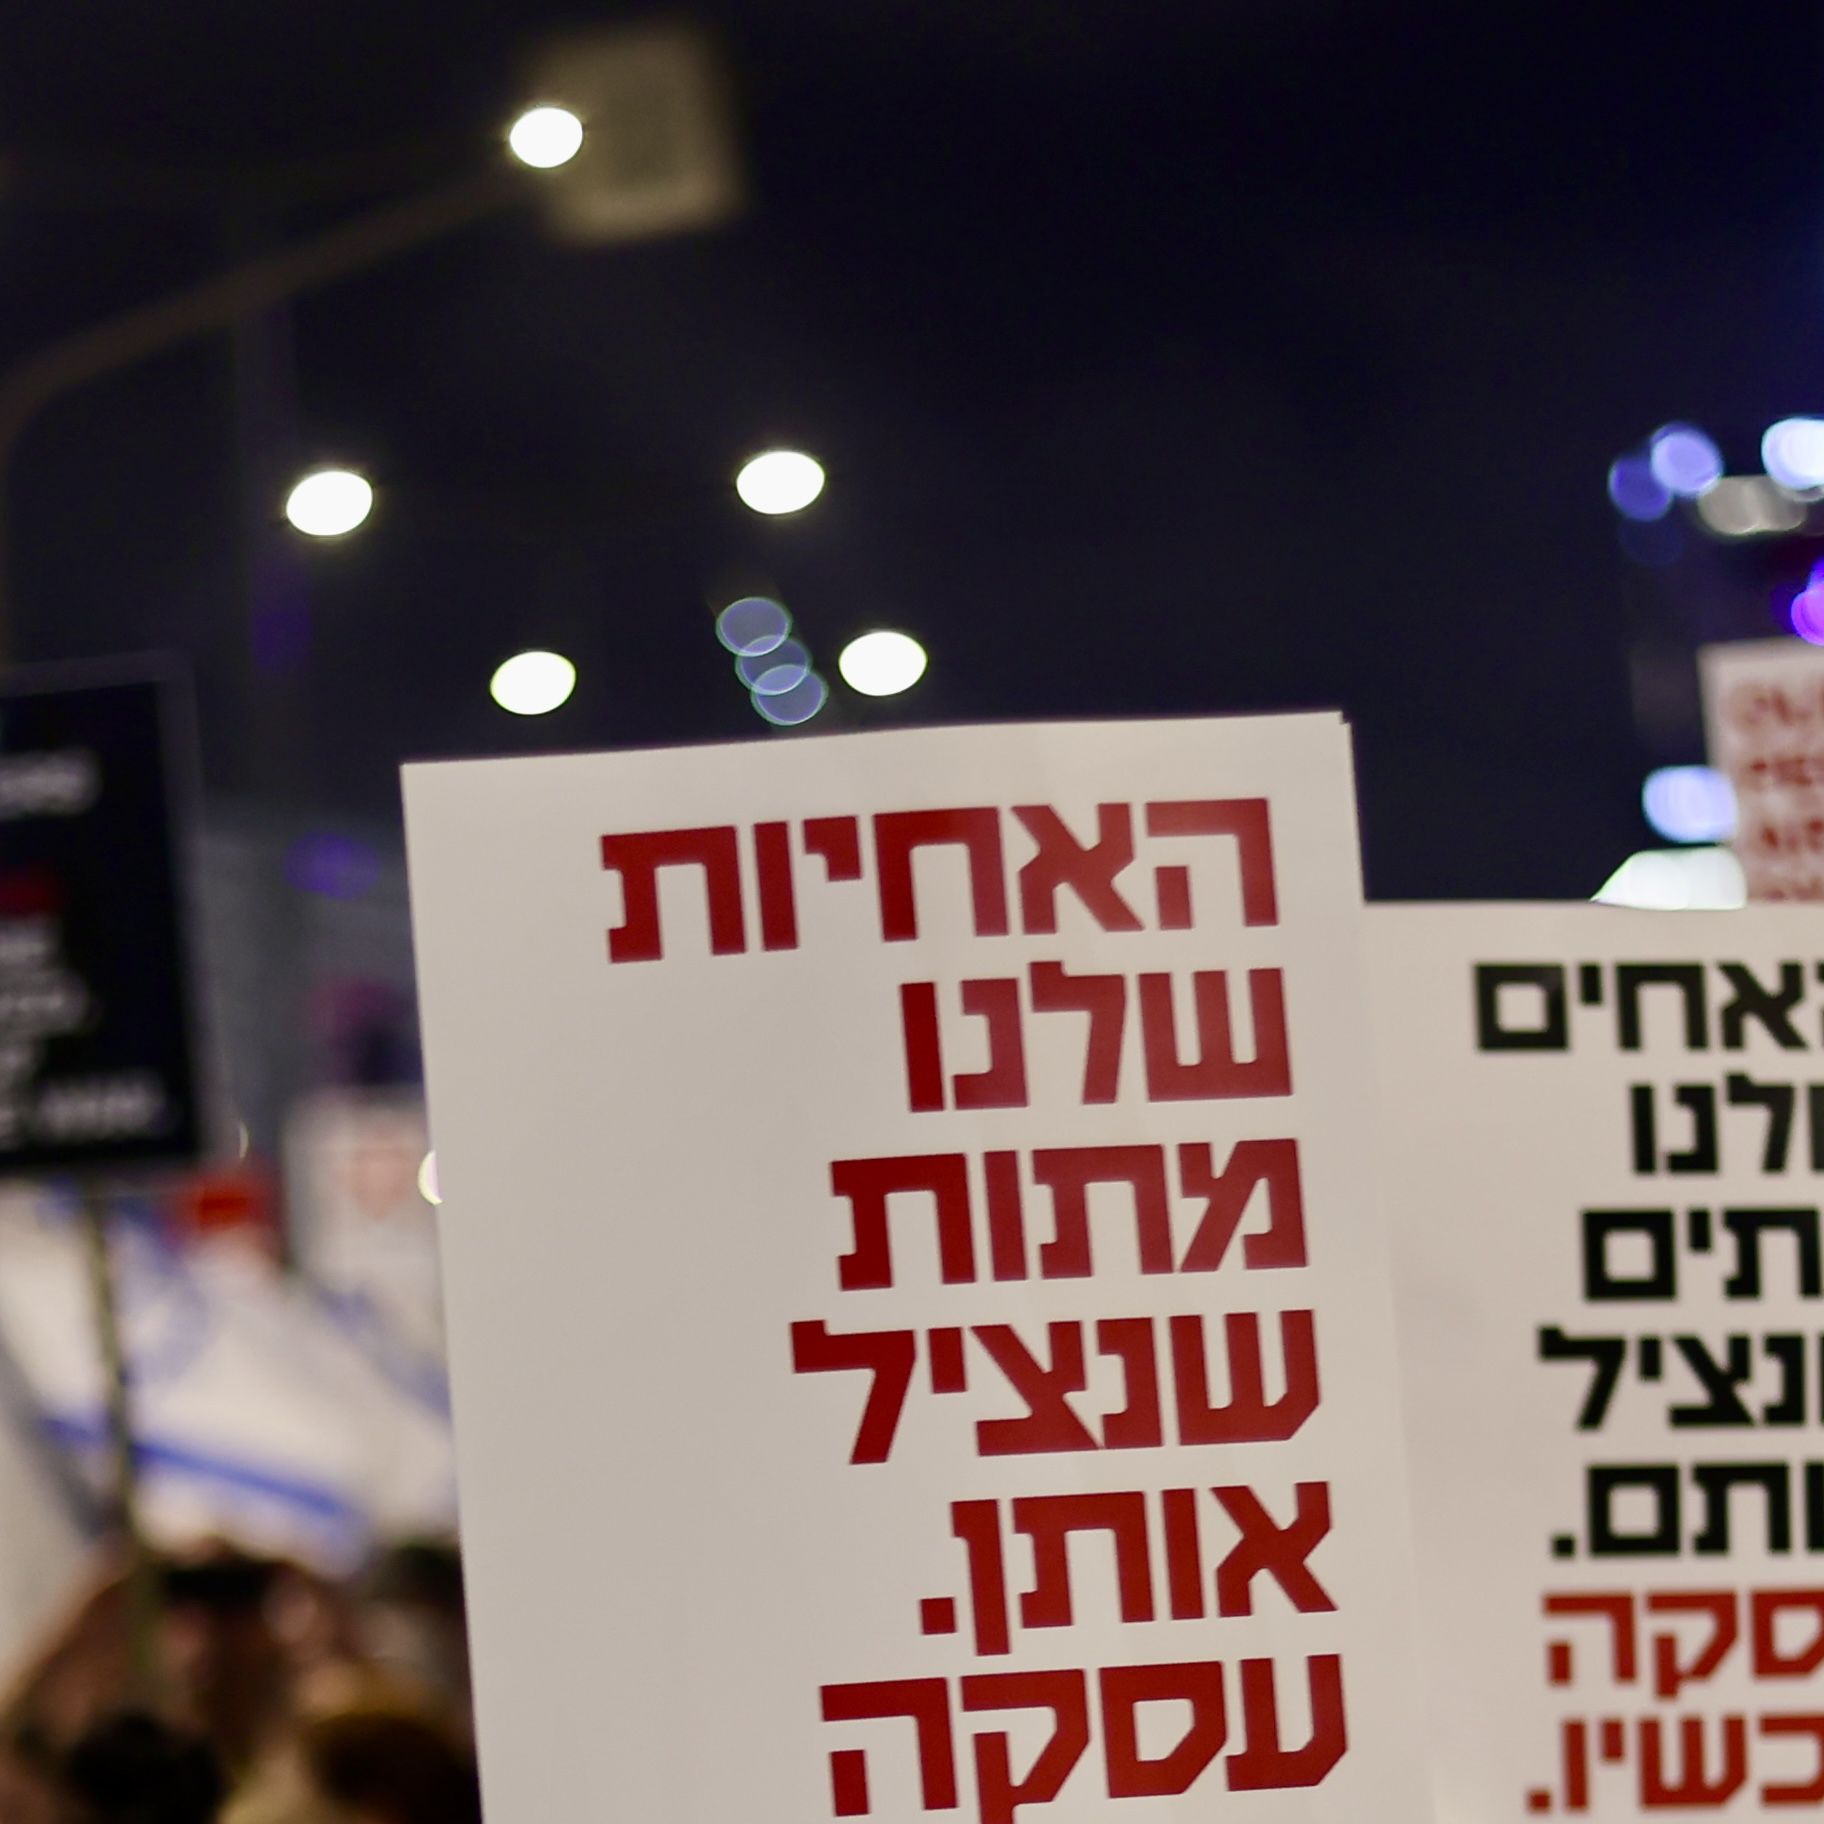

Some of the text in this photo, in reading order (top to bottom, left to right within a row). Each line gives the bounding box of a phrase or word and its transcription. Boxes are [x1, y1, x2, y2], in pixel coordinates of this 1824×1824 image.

[601, 798, 1277, 963] האחיות
[900, 961, 1291, 1112] שלנו
[830, 1138, 1306, 1291] מתות
[790, 1310, 1319, 1464] שנציל
[920, 1482, 1337, 1656] אותן.
